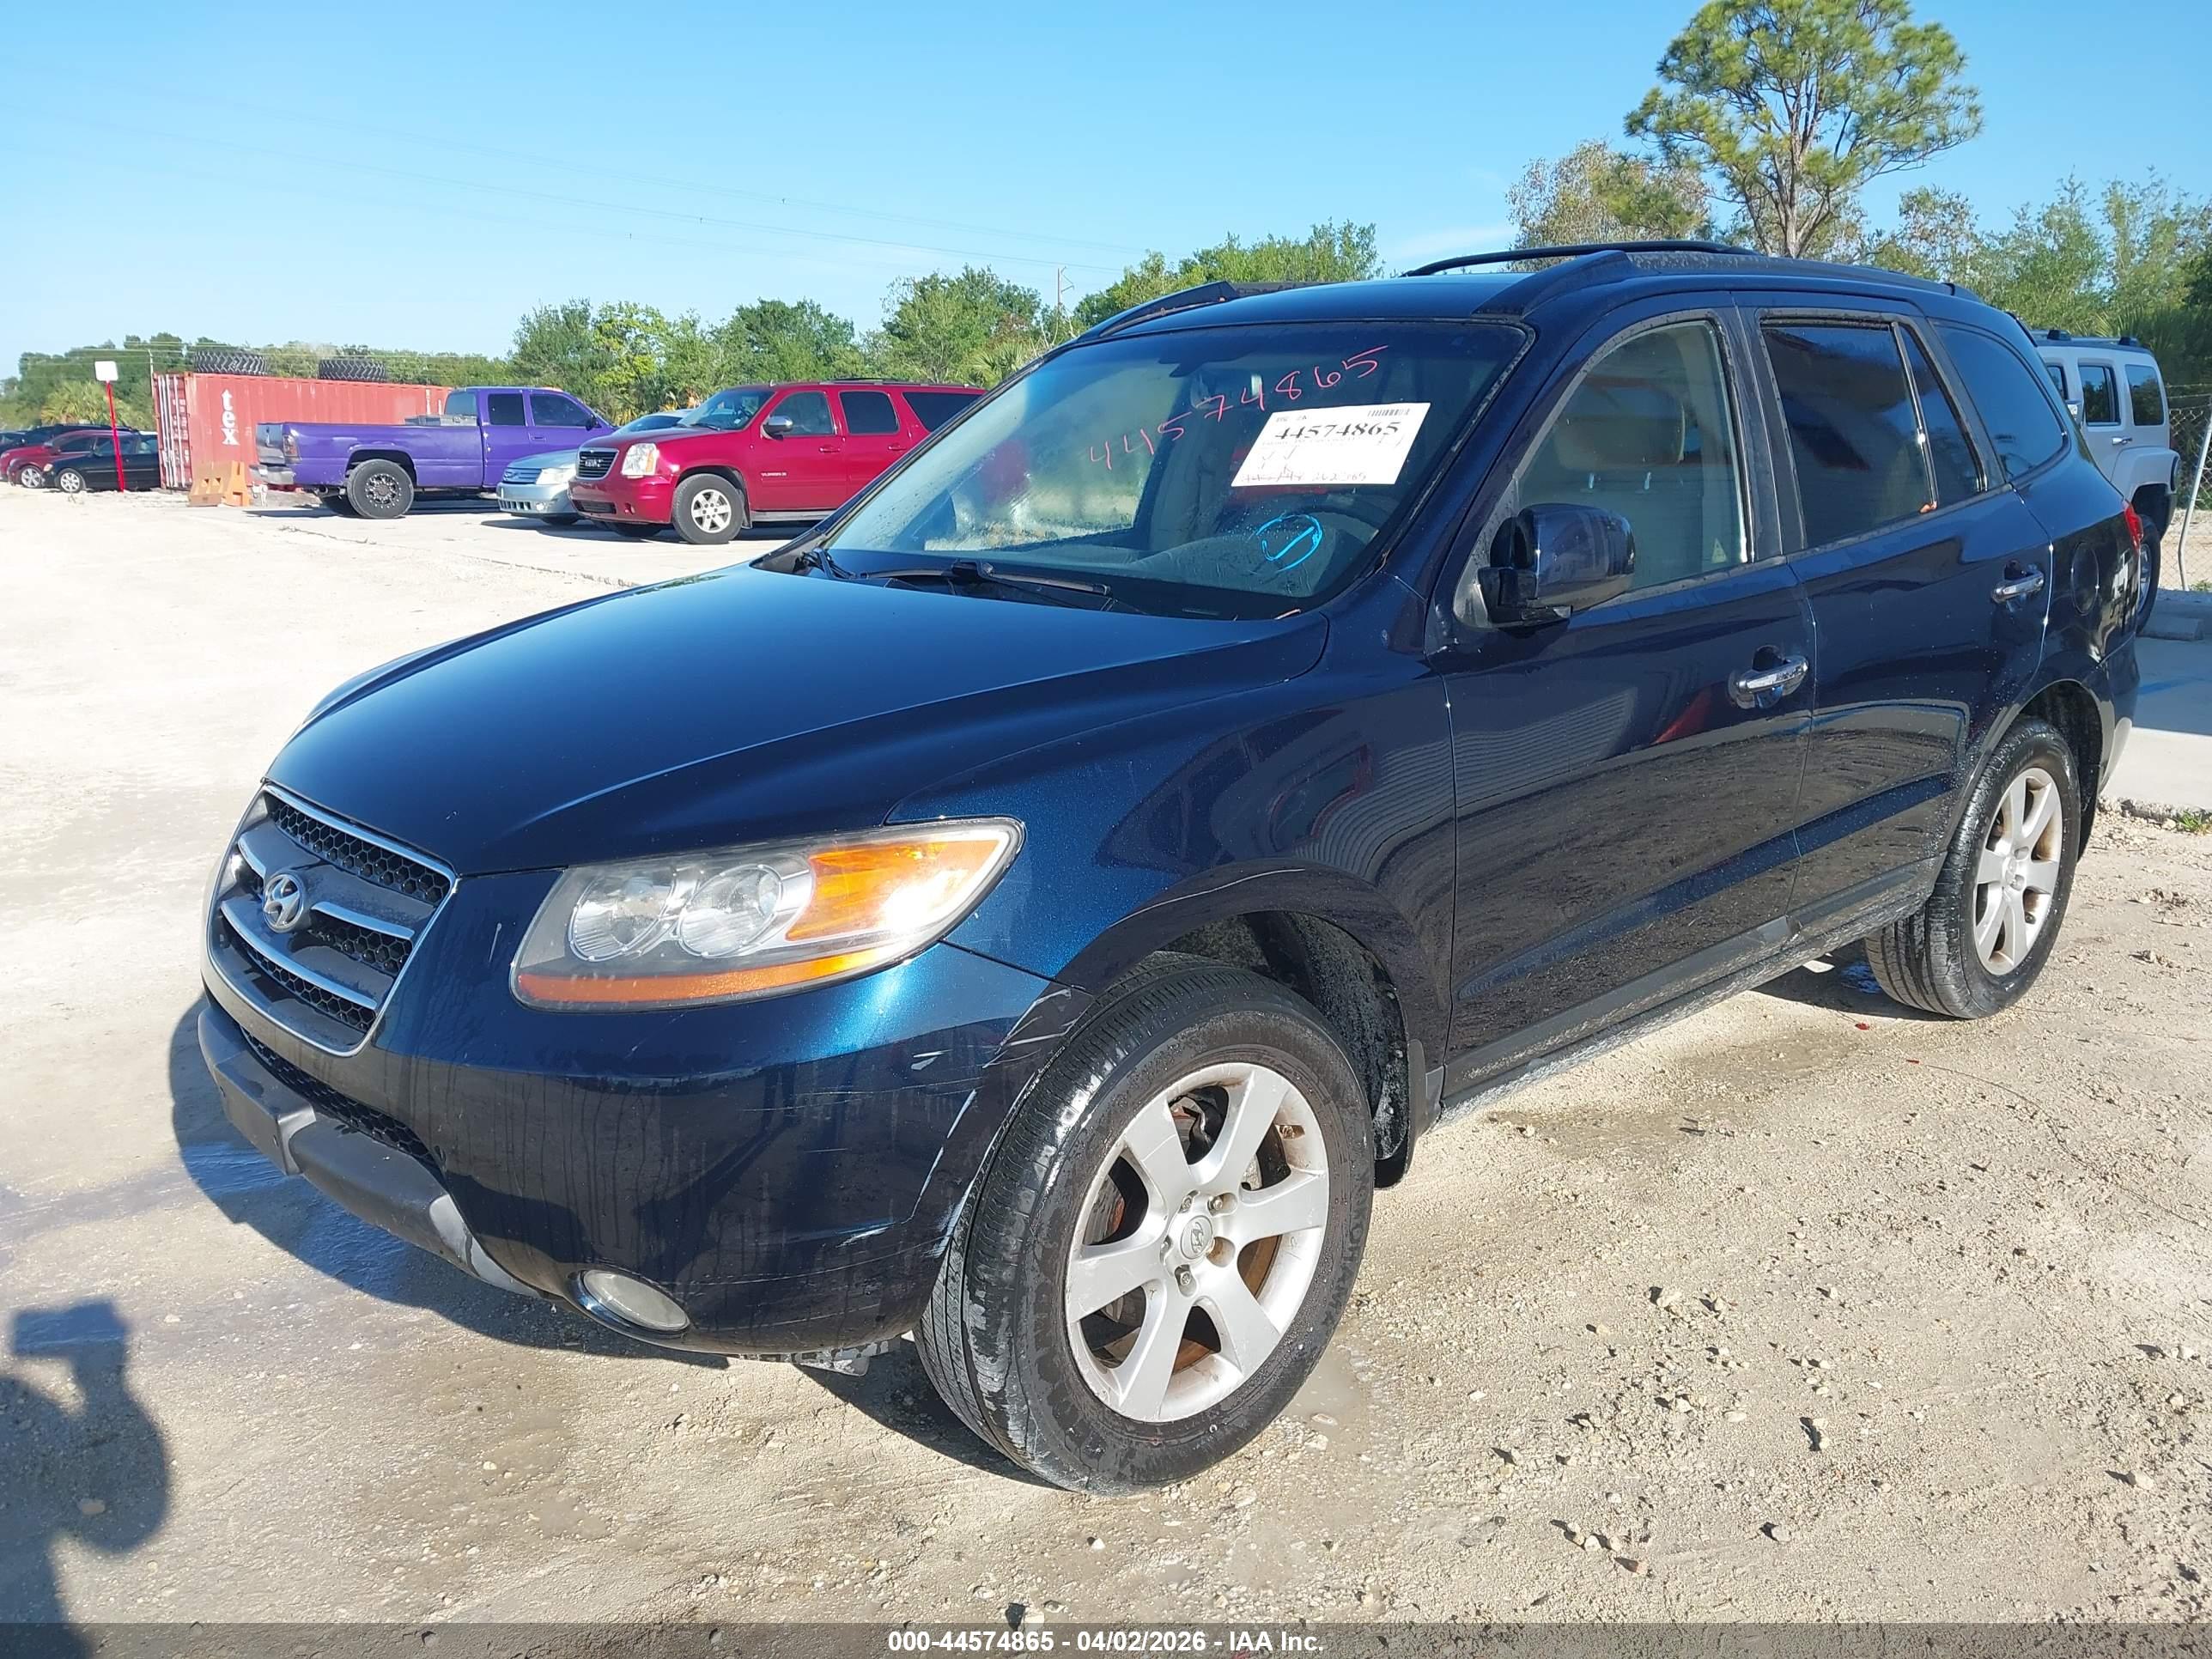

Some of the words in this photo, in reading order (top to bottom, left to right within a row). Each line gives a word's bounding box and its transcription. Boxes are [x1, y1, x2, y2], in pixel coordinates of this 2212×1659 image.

[221, 389, 240, 446] tex
[1090, 345, 1389, 470] 44574865
[1275, 422, 1401, 441] 44574865
